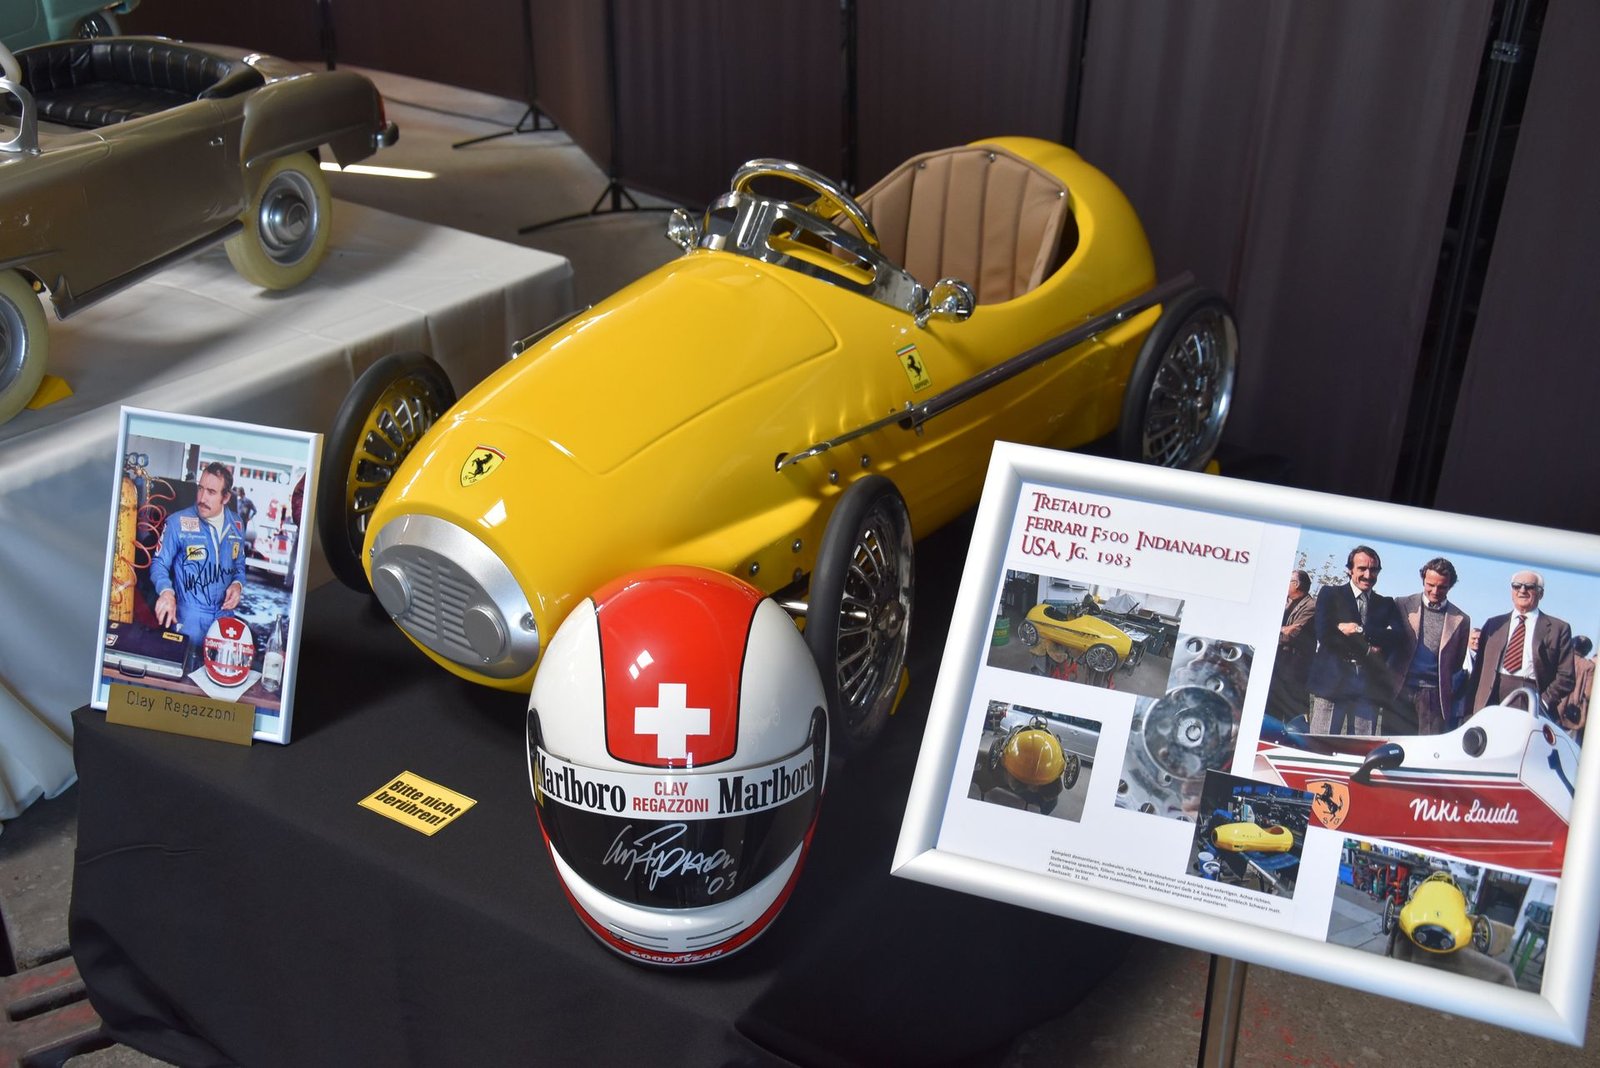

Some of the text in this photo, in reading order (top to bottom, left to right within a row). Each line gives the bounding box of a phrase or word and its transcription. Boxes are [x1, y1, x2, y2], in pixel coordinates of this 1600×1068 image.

[1091, 526, 1129, 543] F500
[1097, 552, 1131, 568] 1983
[126, 690, 236, 722] Clay Regazzoni
[654, 781, 688, 796] CLAY
[718, 759, 814, 814] Marlboro
[374, 790, 447, 826] berühren!
[388, 780, 461, 817] Bitte nicht
[633, 797, 709, 813] REGAZZONI
[1464, 799, 1519, 824] Lauda
[629, 949, 723, 963] GOODYEAR
